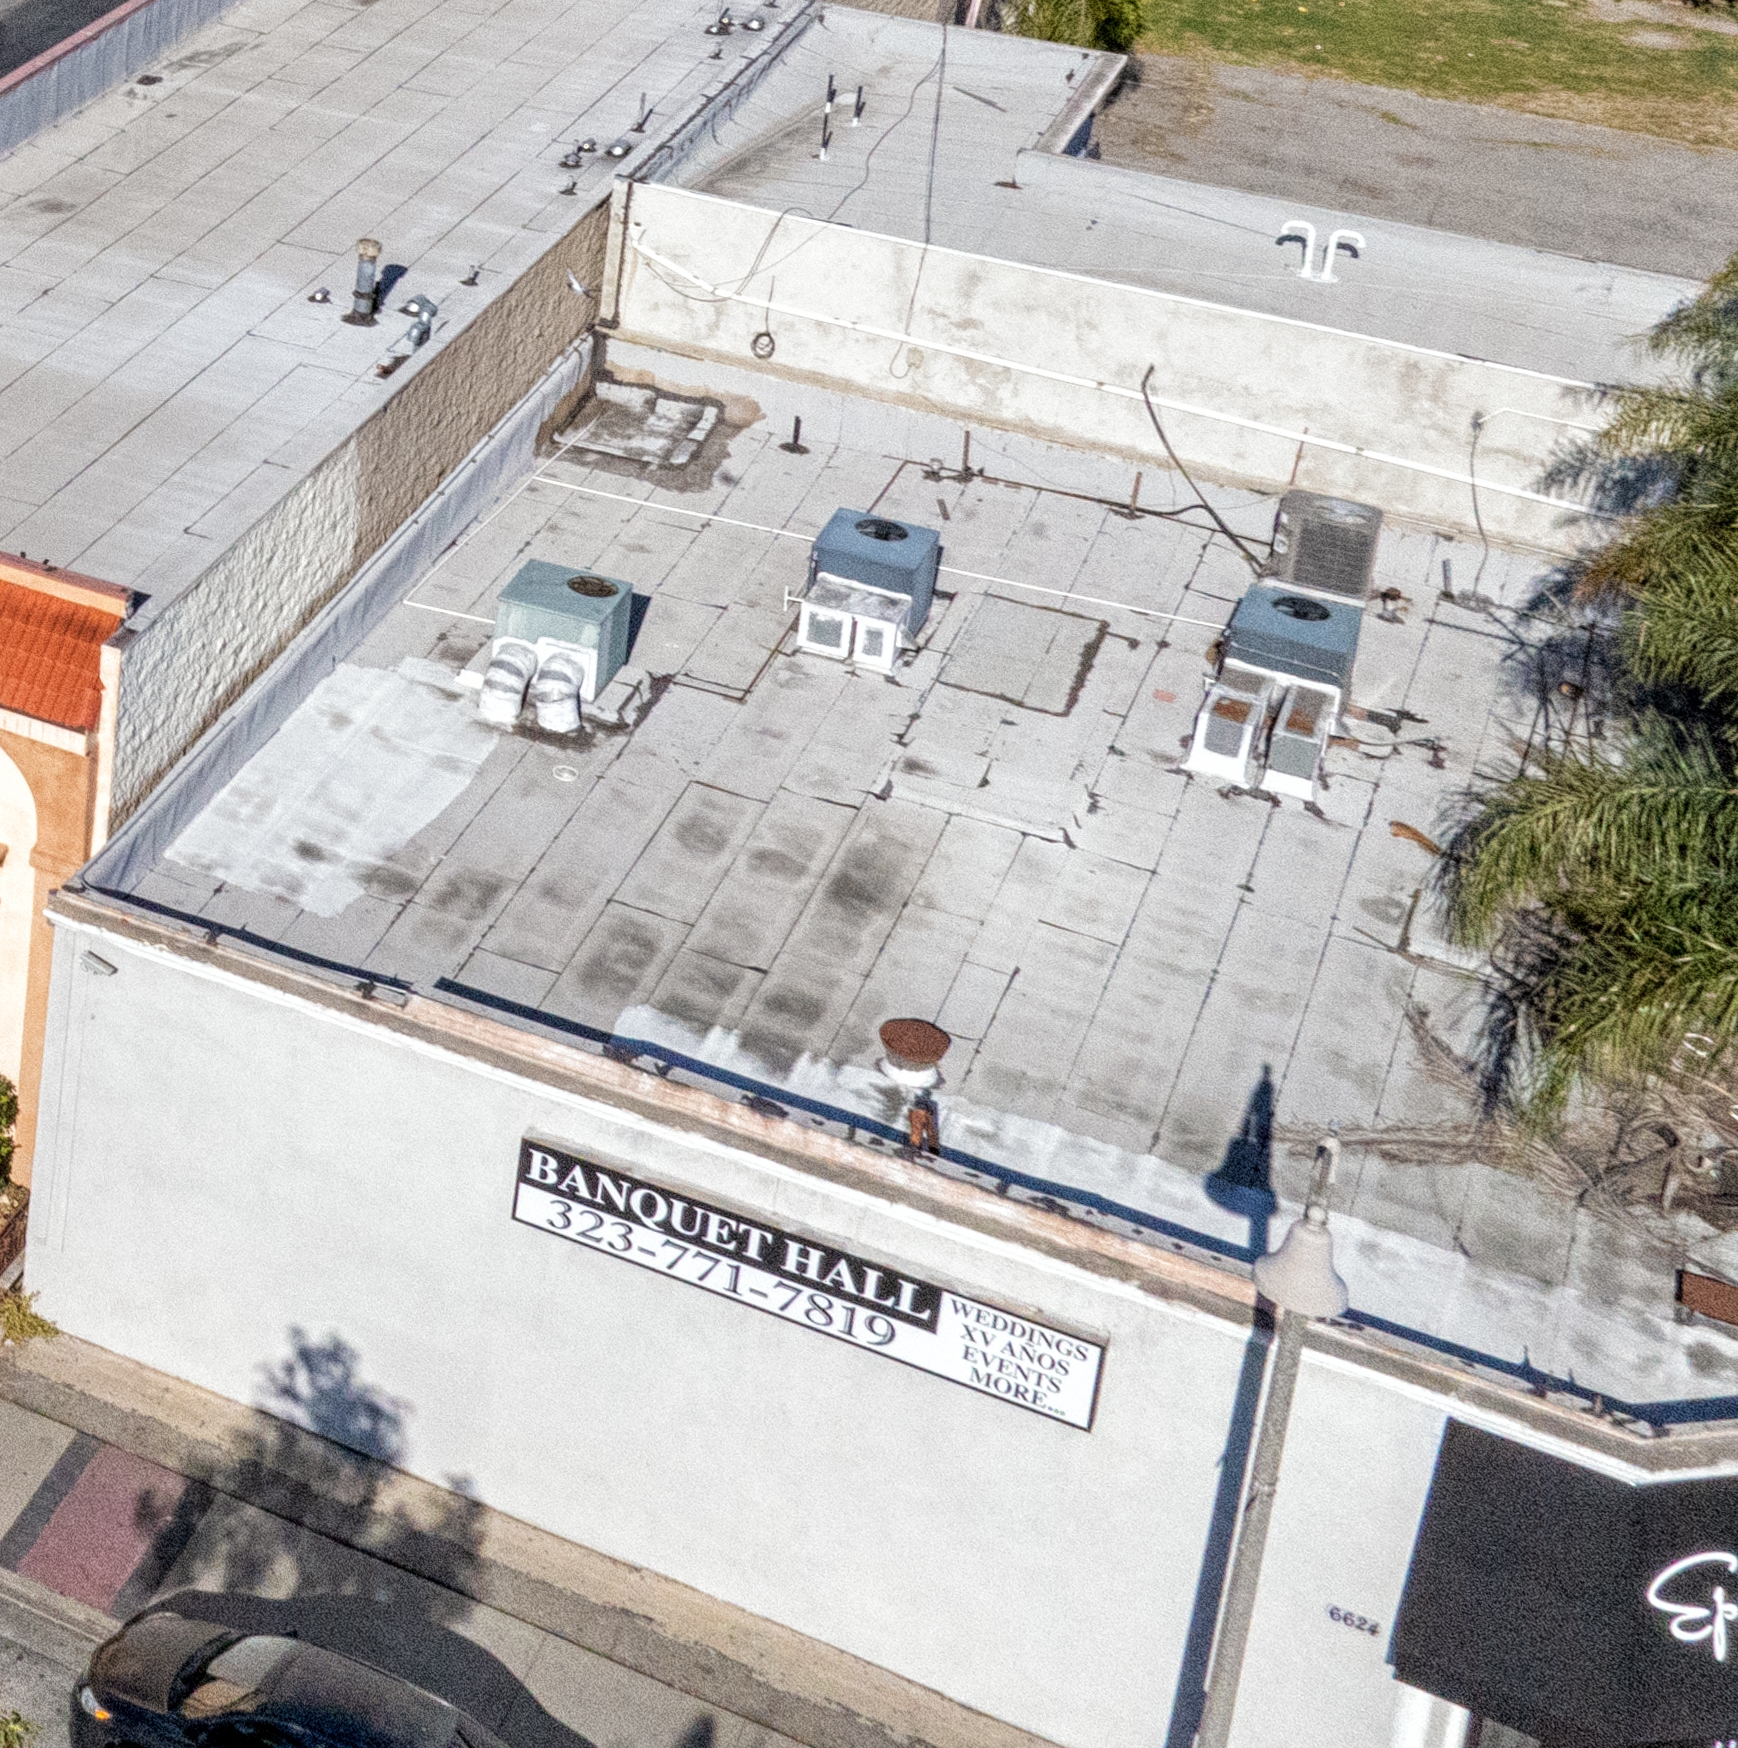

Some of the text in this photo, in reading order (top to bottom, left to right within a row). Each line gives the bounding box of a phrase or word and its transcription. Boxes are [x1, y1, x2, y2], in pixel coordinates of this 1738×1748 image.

[525, 1147, 934, 1322] BANQUET HALL
[545, 1199, 897, 1346] 323-771-7819
[951, 1298, 1089, 1362] WEDDINGS
[961, 1323, 1070, 1376] XV AÑOS
[962, 1344, 1062, 1394] EVENTS
[969, 1366, 1066, 1416] MORE...
[1328, 1605, 1381, 1637] 6624
